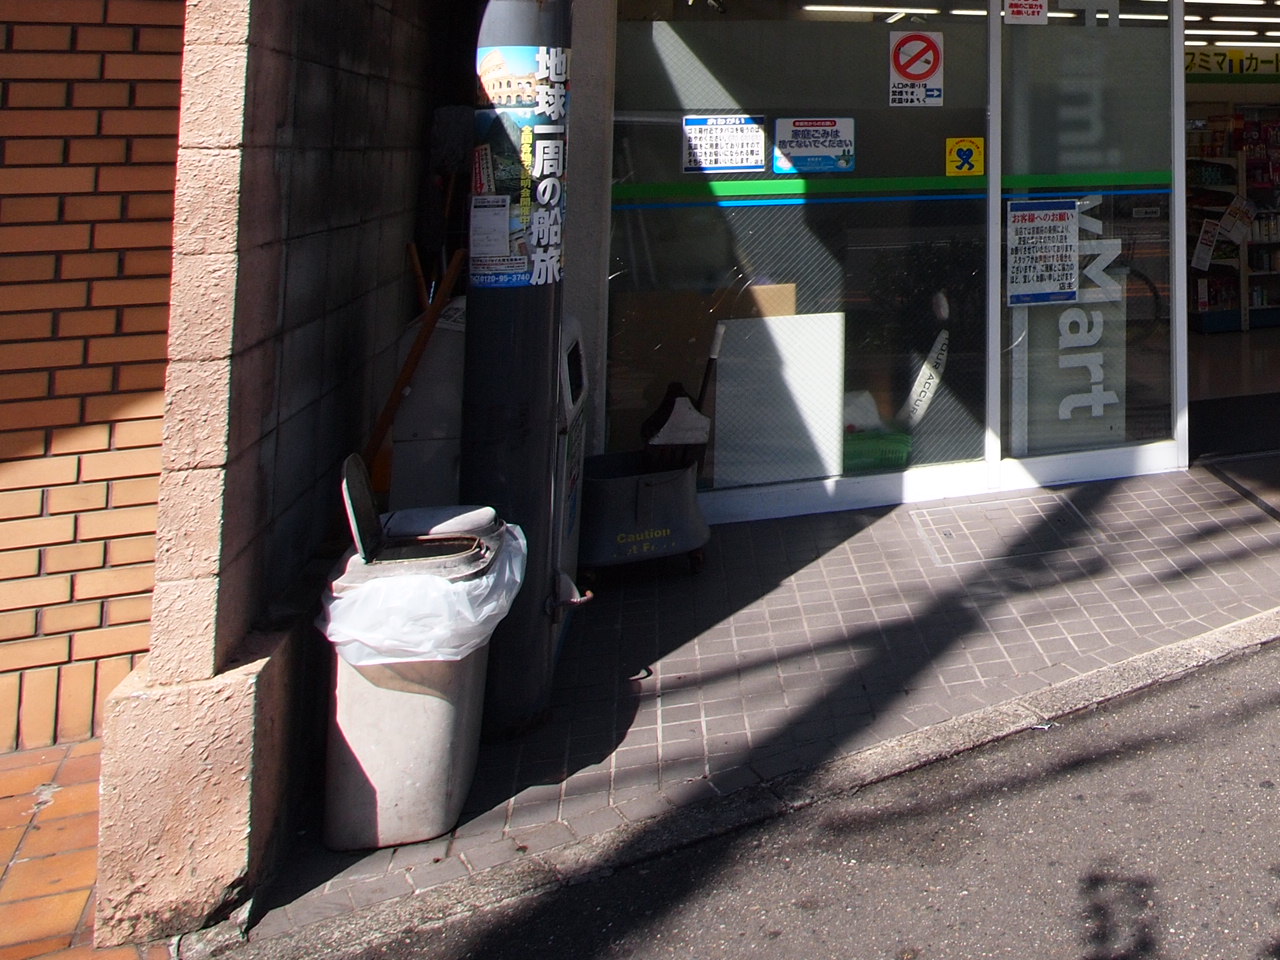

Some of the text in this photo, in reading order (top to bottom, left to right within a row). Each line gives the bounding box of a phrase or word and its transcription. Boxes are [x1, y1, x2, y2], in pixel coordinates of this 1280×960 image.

[792, 129, 841, 139] 家庭ごみは
[779, 139, 853, 149] 捨てないでください
[530, 47, 567, 286] 地球一周の船旅
[1012, 212, 1074, 224] お客様へのお願い
[616, 528, 672, 544] Caution
